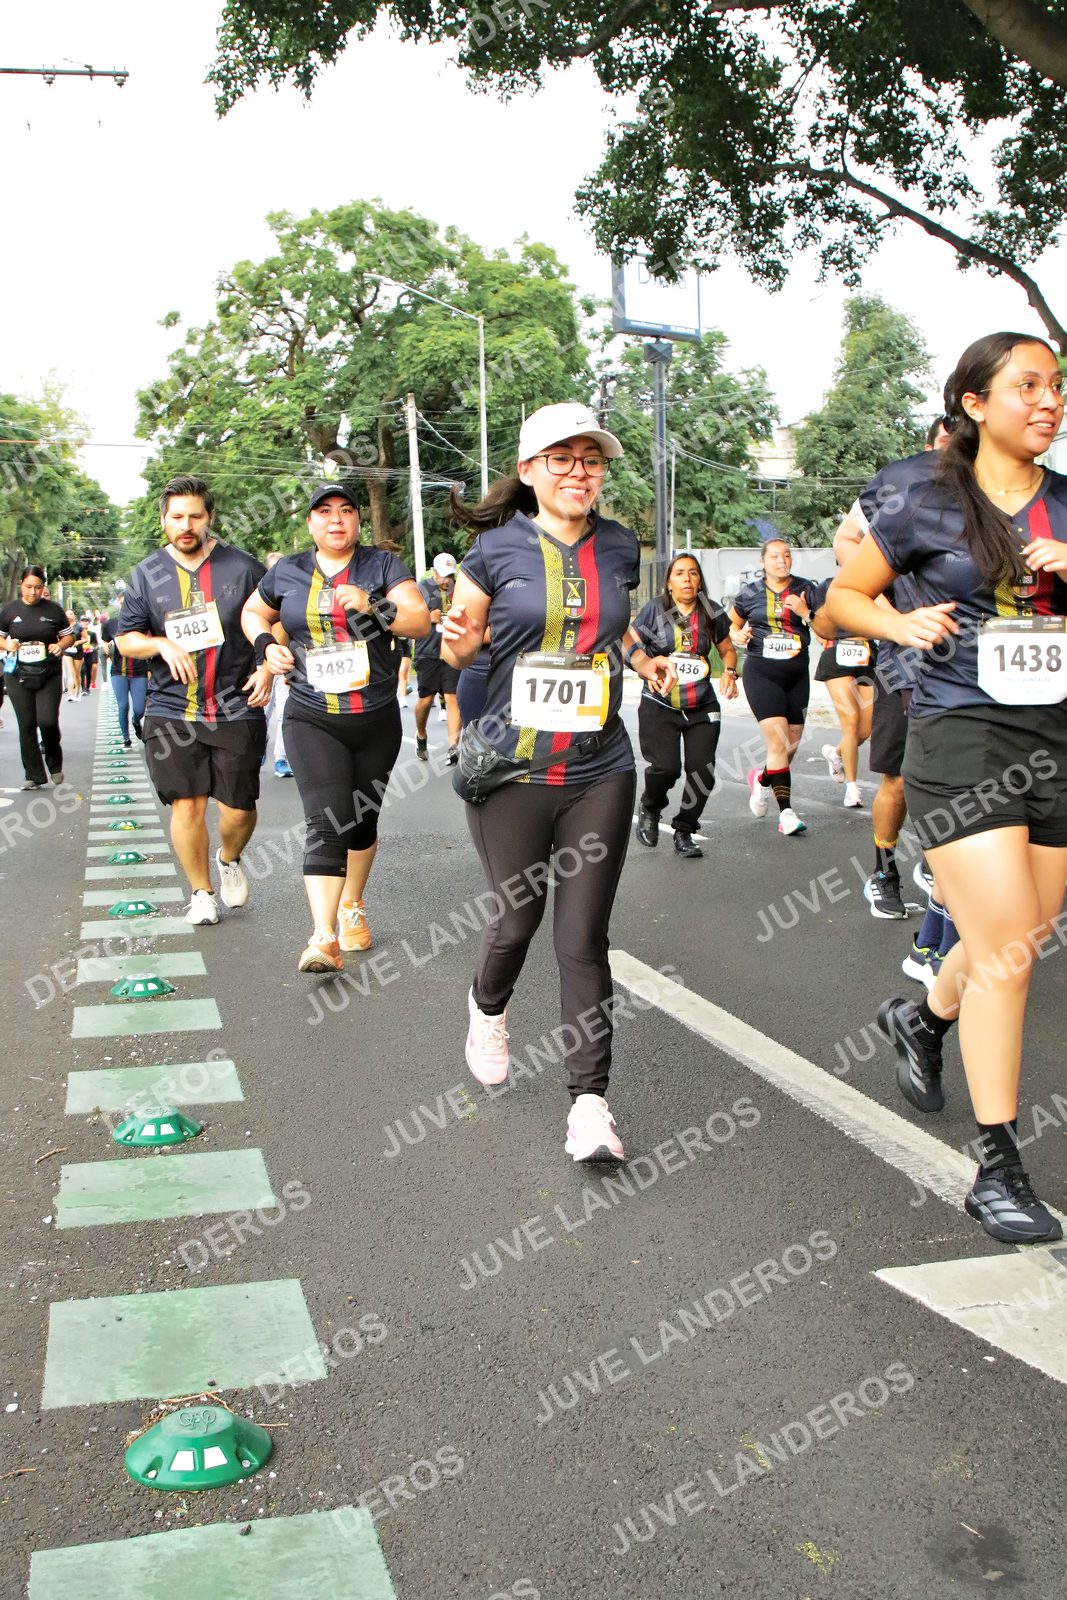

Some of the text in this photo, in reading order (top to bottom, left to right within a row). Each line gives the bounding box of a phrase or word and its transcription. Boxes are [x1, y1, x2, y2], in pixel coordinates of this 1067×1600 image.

[173, 619, 209, 639] 3483
[315, 658, 356, 678] 3482
[993, 644, 1062, 673] 1438
[525, 677, 587, 705] 1701
